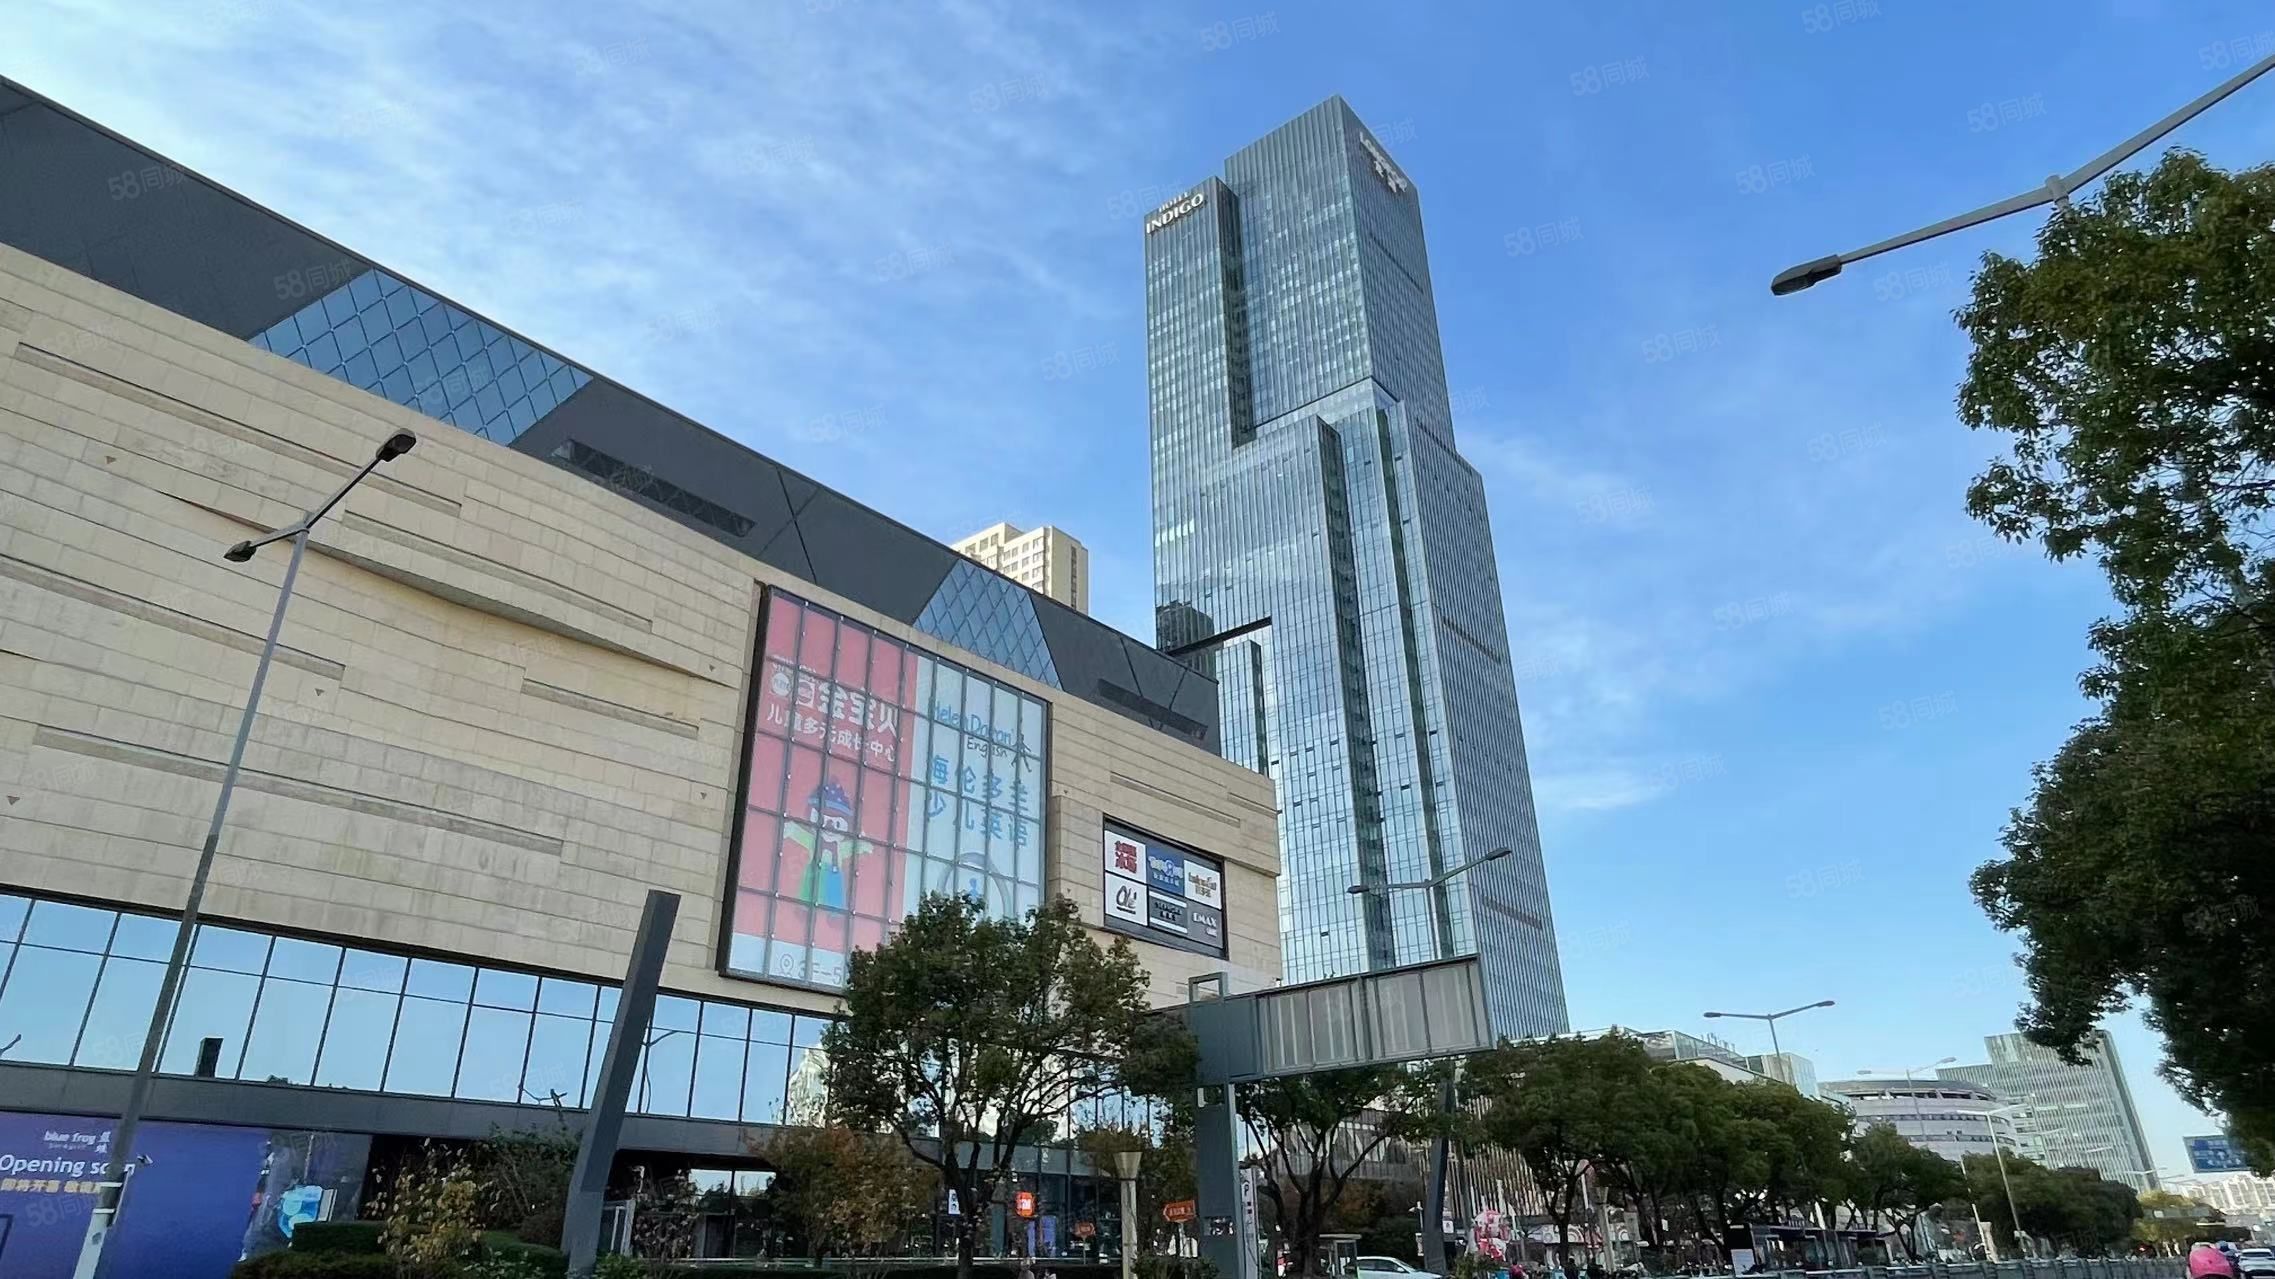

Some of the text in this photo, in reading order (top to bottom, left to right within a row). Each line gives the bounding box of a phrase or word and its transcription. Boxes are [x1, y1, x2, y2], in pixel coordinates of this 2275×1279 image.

[1146, 193, 1204, 234] INDIGO
[966, 736, 1008, 758] Engish
[43, 1130, 97, 1145] blue frog
[0, 1154, 86, 1178] Opening
